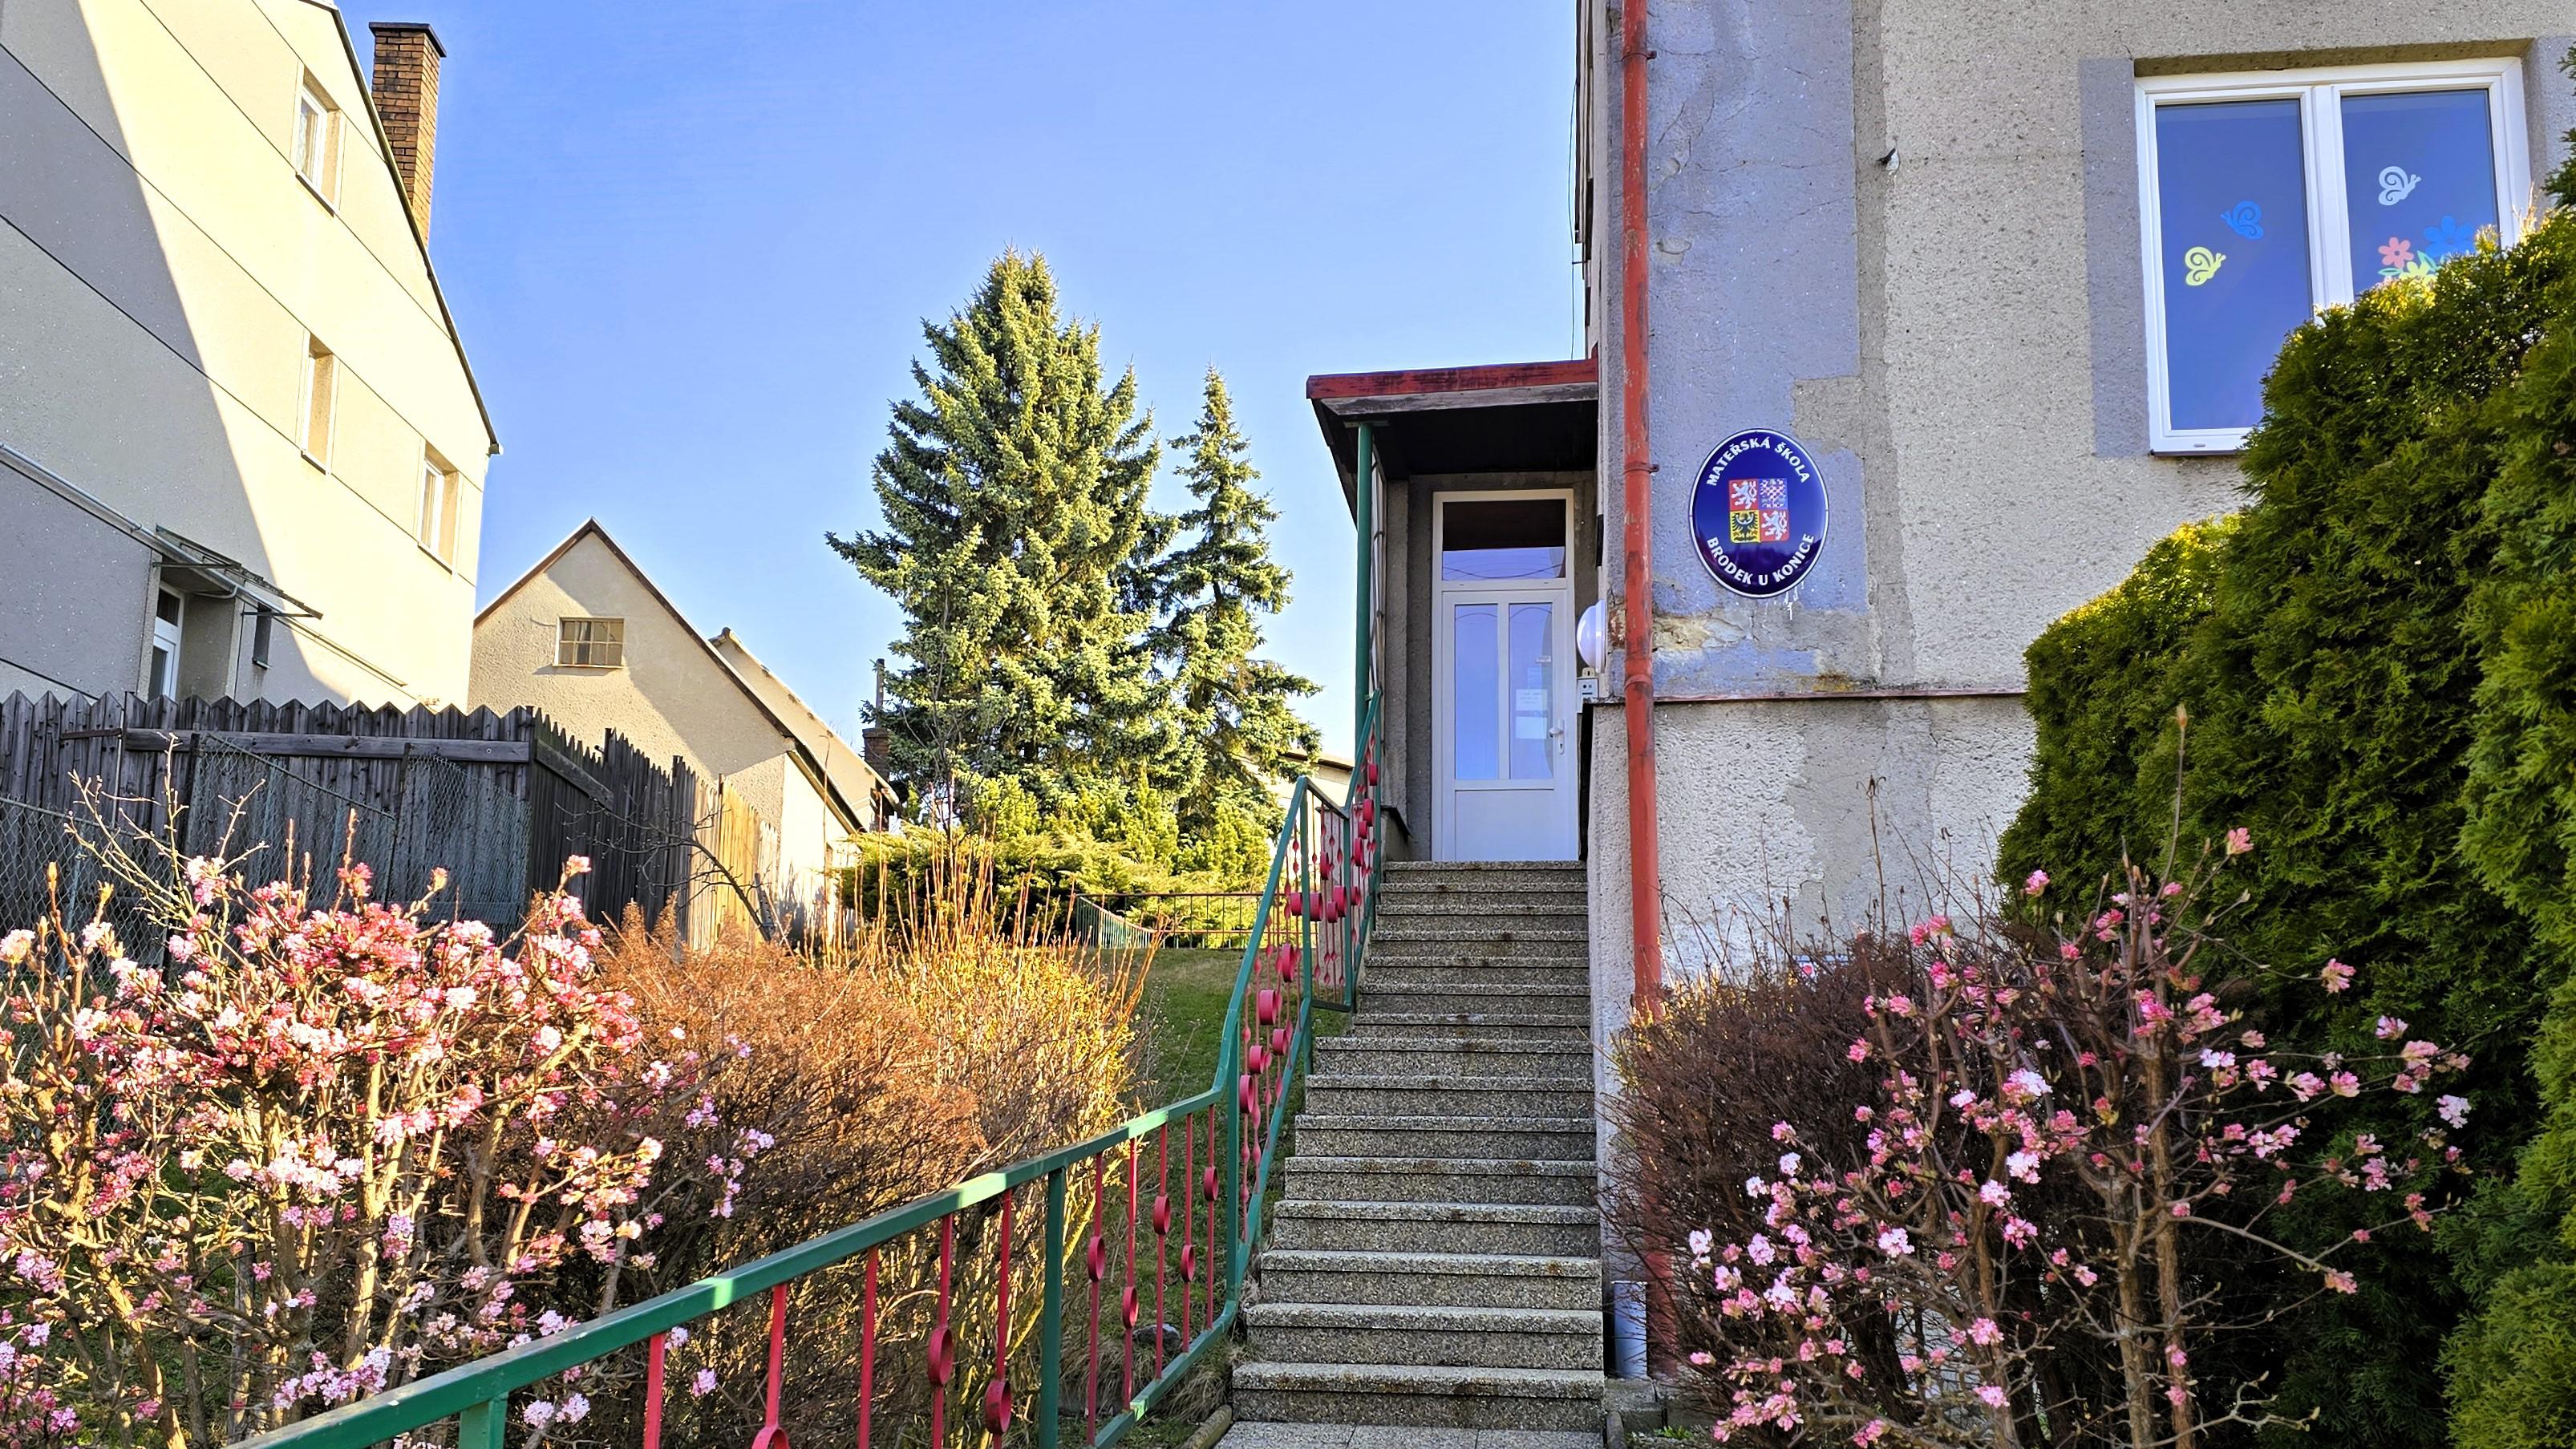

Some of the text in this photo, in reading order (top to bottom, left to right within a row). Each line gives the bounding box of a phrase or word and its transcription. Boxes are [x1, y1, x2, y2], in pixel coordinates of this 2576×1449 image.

[1707, 436, 1810, 486] MATEŘSKÁ ŠKOLA
[1707, 533, 1814, 586] BRODEK U KONICE
